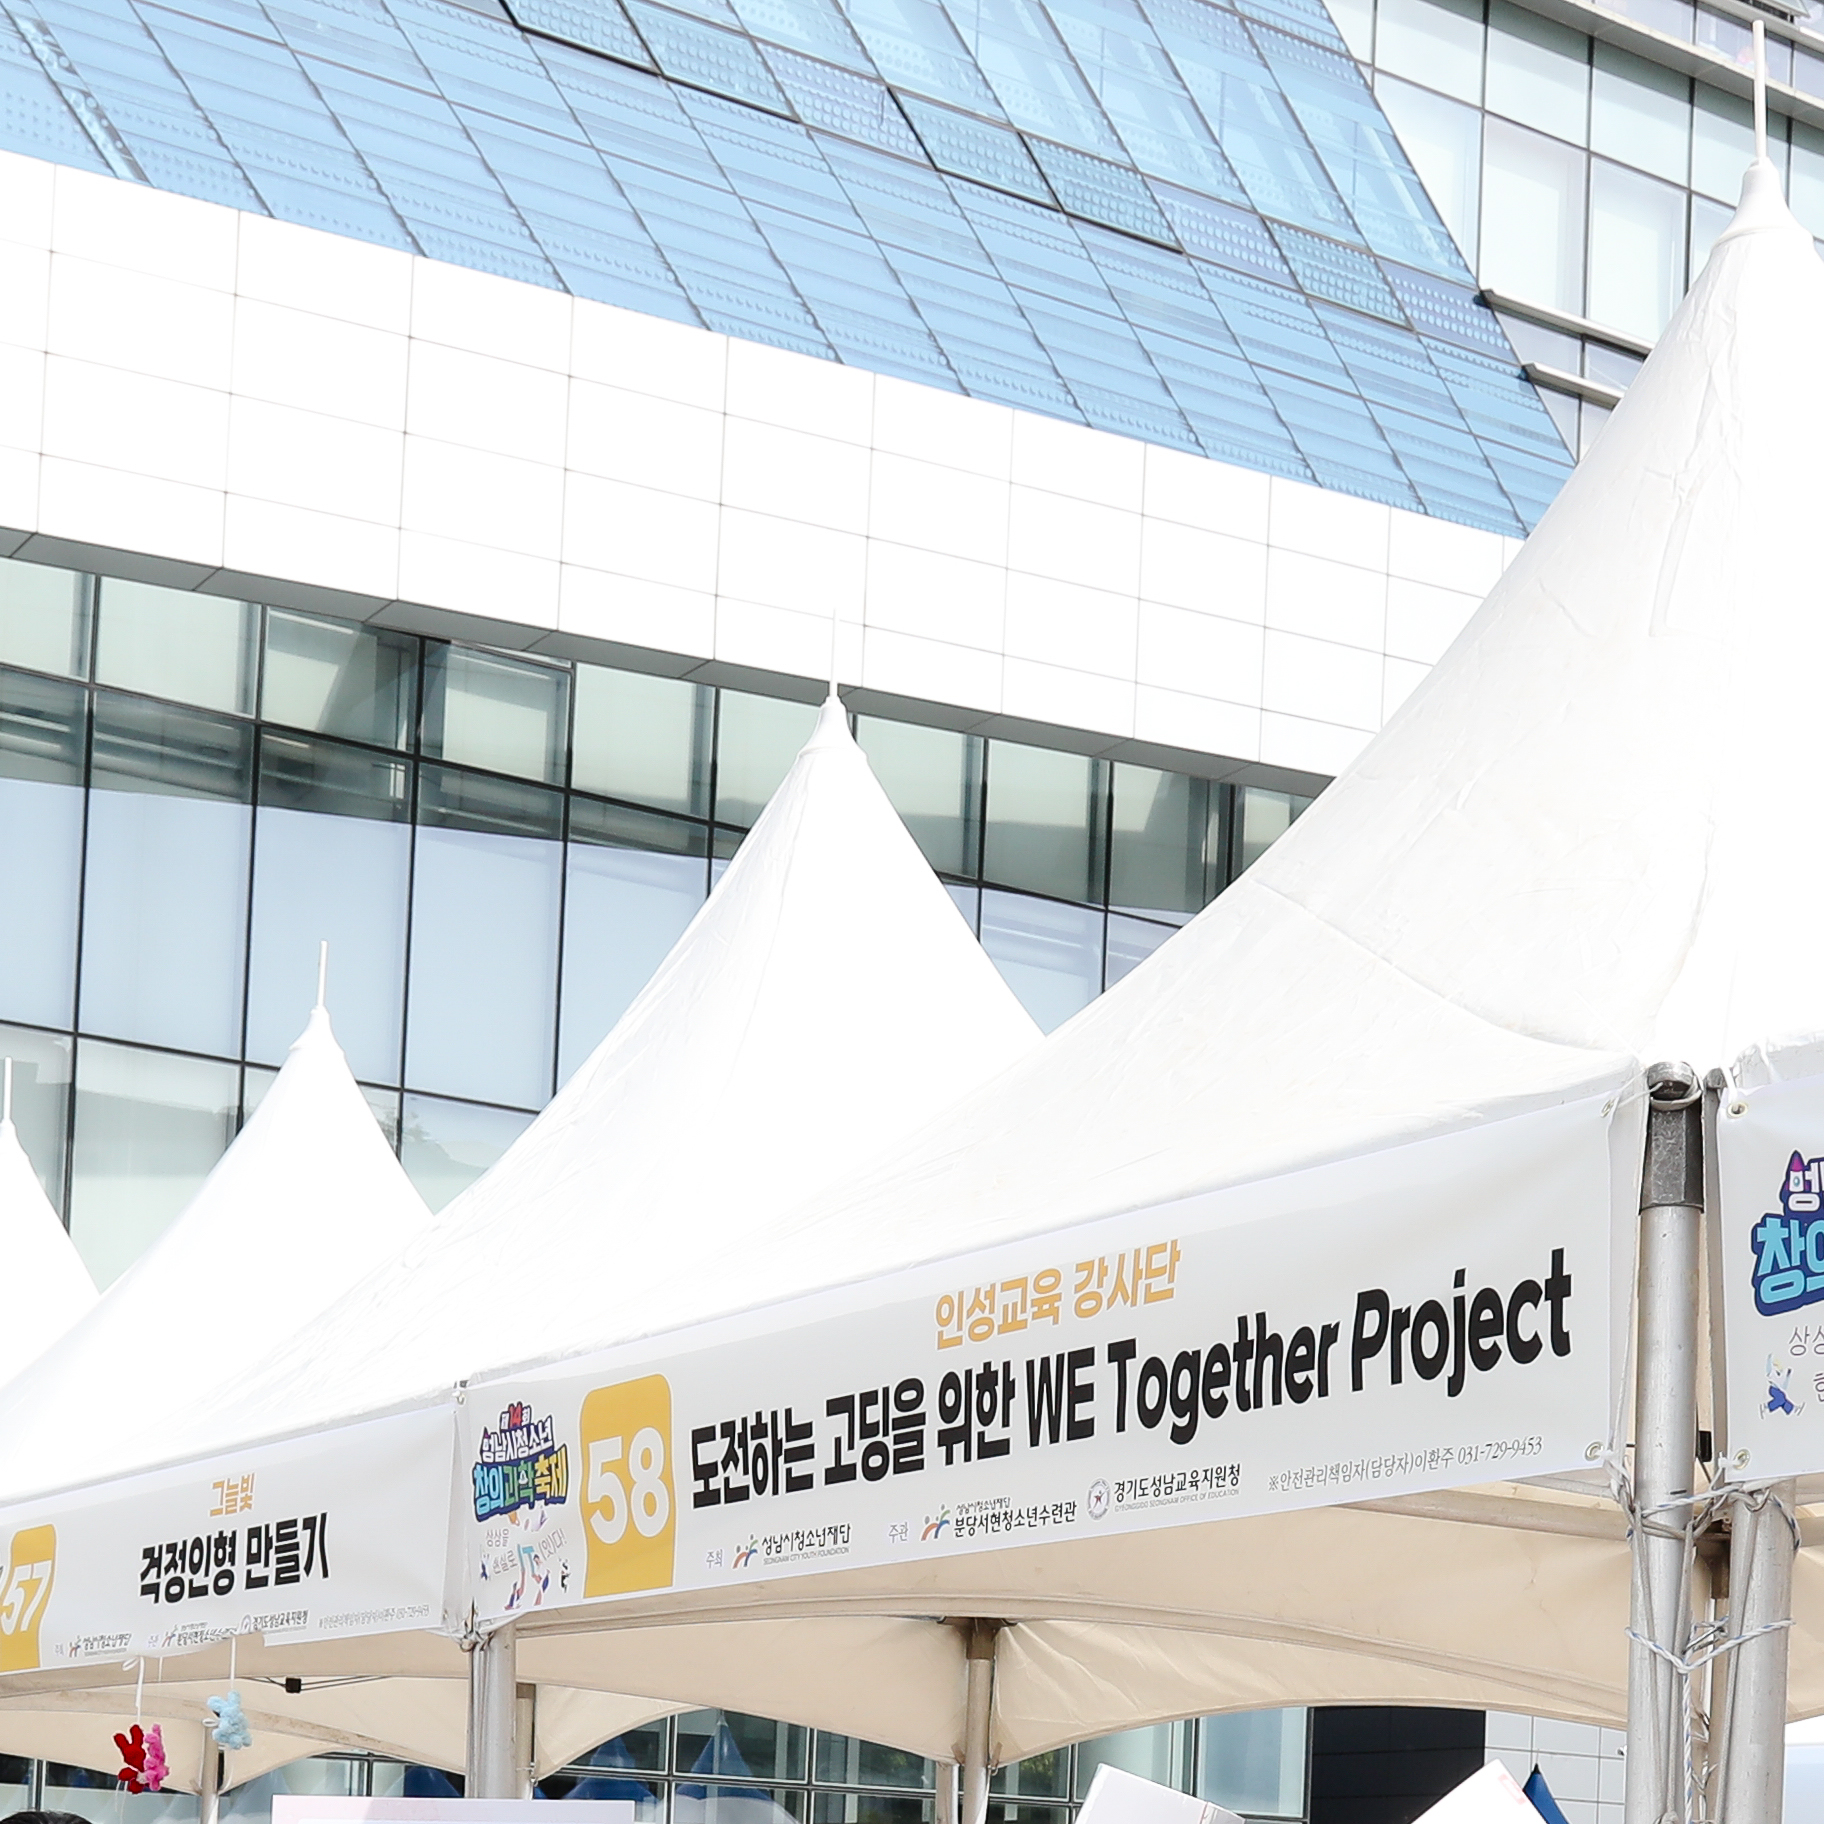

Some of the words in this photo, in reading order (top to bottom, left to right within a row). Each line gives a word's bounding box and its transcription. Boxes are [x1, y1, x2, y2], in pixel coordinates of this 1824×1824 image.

[935, 1268, 1062, 1350] 인성교육
[1074, 1240, 1182, 1318] 강사단
[691, 1408, 814, 1509] 도전하는
[823, 1378, 926, 1487] 고딩을
[937, 1361, 1015, 1466] 위한
[1027, 1345, 1095, 1447] WE
[1107, 1311, 1341, 1445] Together
[1351, 1246, 1572, 1398] Project
[1457, 1435, 1544, 1467] 031-729-9453
[587, 1427, 669, 1545] 58
[1113, 1463, 1241, 1504] 경기도성남교육지원청
[761, 1523, 851, 1556] 성남시청소년재단
[888, 1521, 908, 1543] 주관
[954, 1501, 1077, 1538] 분당서현청소년수련관
[140, 1530, 237, 1604] 걱정인형
[244, 1512, 329, 1590] 만들기
[705, 1548, 723, 1569] 주최
[1, 1560, 51, 1636] 57
